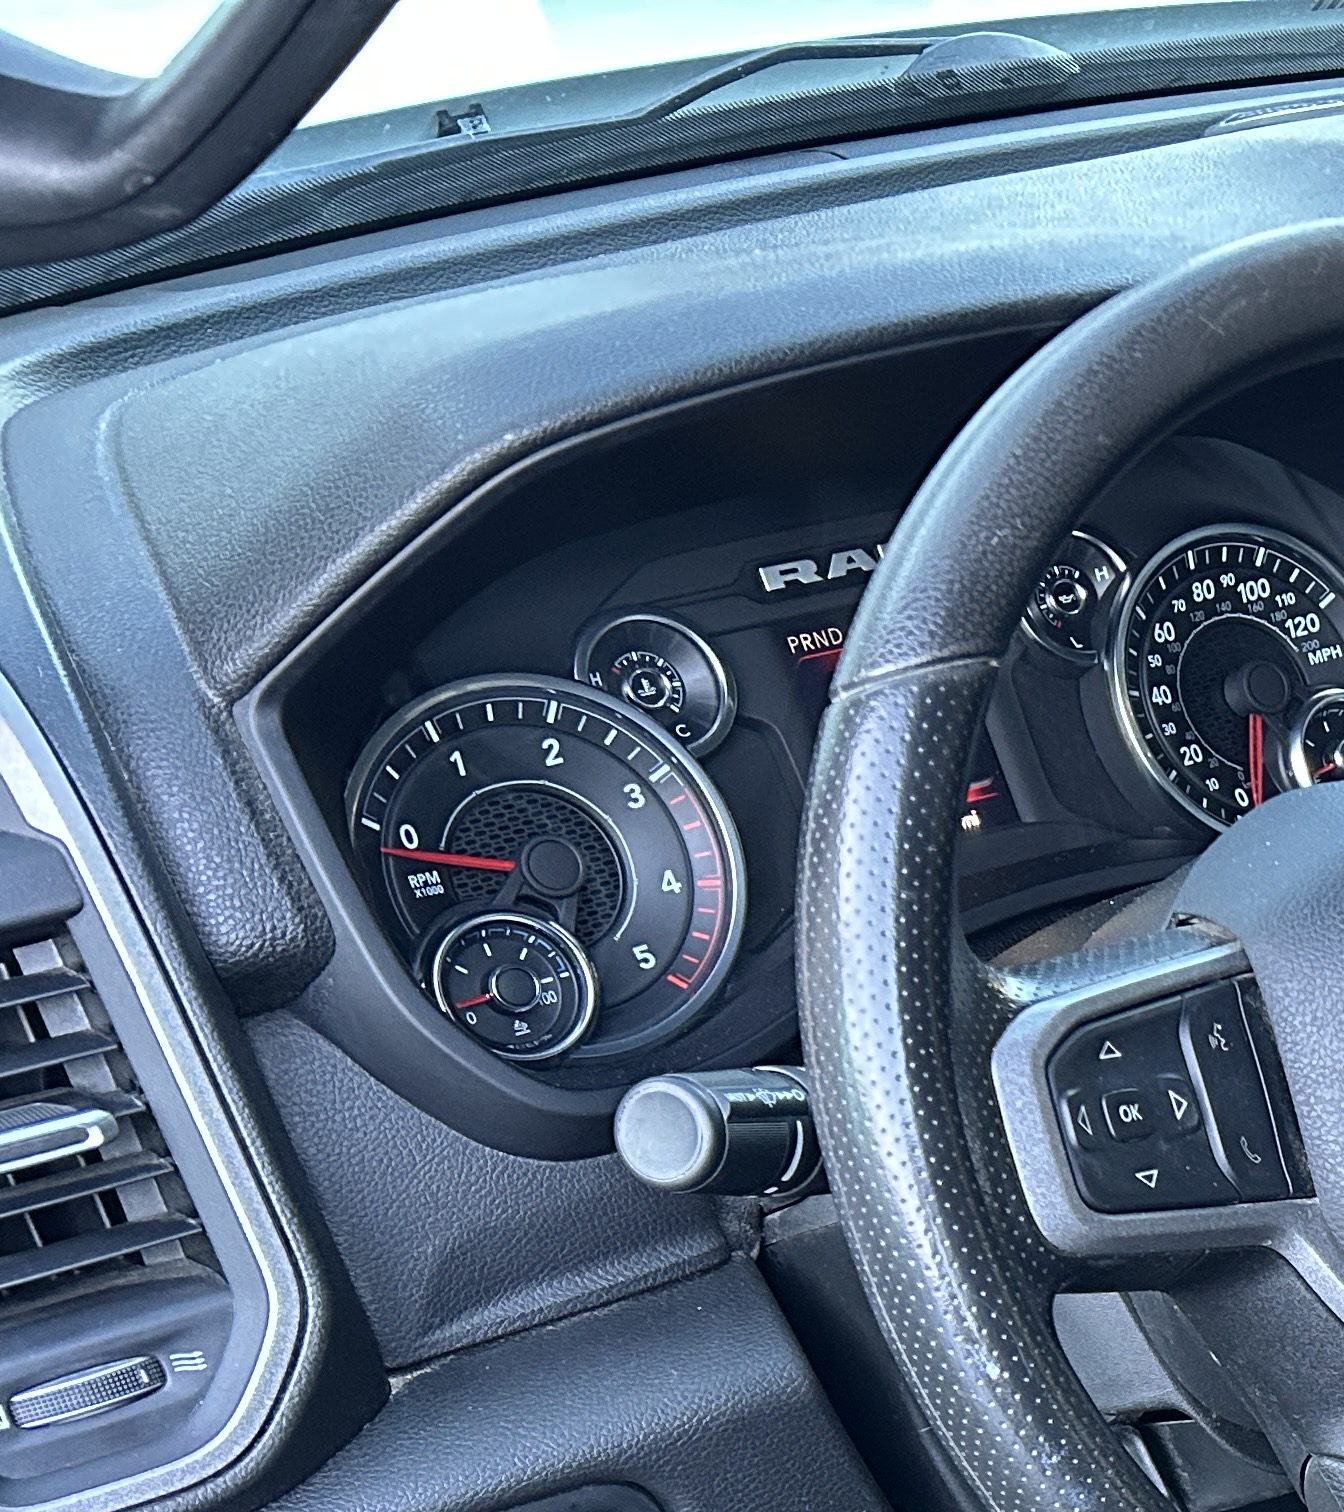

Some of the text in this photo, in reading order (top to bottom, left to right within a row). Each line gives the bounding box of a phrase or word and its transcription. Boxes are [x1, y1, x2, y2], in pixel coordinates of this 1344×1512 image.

[1094, 565, 1110, 582] H
[1220, 572, 1236, 588] 90
[1191, 578, 1215, 602] 80
[1236, 577, 1271, 604] 100
[1274, 591, 1296, 608] 110
[1171, 598, 1187, 613] 70
[1247, 600, 1265, 614] 160
[1153, 621, 1176, 643] 60
[1284, 612, 1320, 639] 120
[786, 627, 843, 655] PRND
[1300, 639, 1320, 653] 200
[1147, 653, 1163, 668] 50
[1307, 644, 1343, 666] MPH
[589, 671, 603, 687] H
[1151, 684, 1173, 706] 40
[675, 724, 692, 737] C
[1161, 722, 1177, 736] 30
[541, 738, 565, 767] 2
[1179, 743, 1204, 767] 20
[449, 749, 467, 778] 1
[1205, 777, 1220, 792] 10
[623, 783, 647, 809] 3
[1234, 787, 1250, 808] 0
[398, 823, 419, 850] 0
[407, 870, 441, 889] RPM
[661, 869, 683, 896] 4
[413, 884, 445, 899] X1000
[632, 943, 657, 971] 5
[539, 990, 558, 1006] 00
[465, 1011, 478, 1025] 0
[1118, 1103, 1143, 1123] OK
